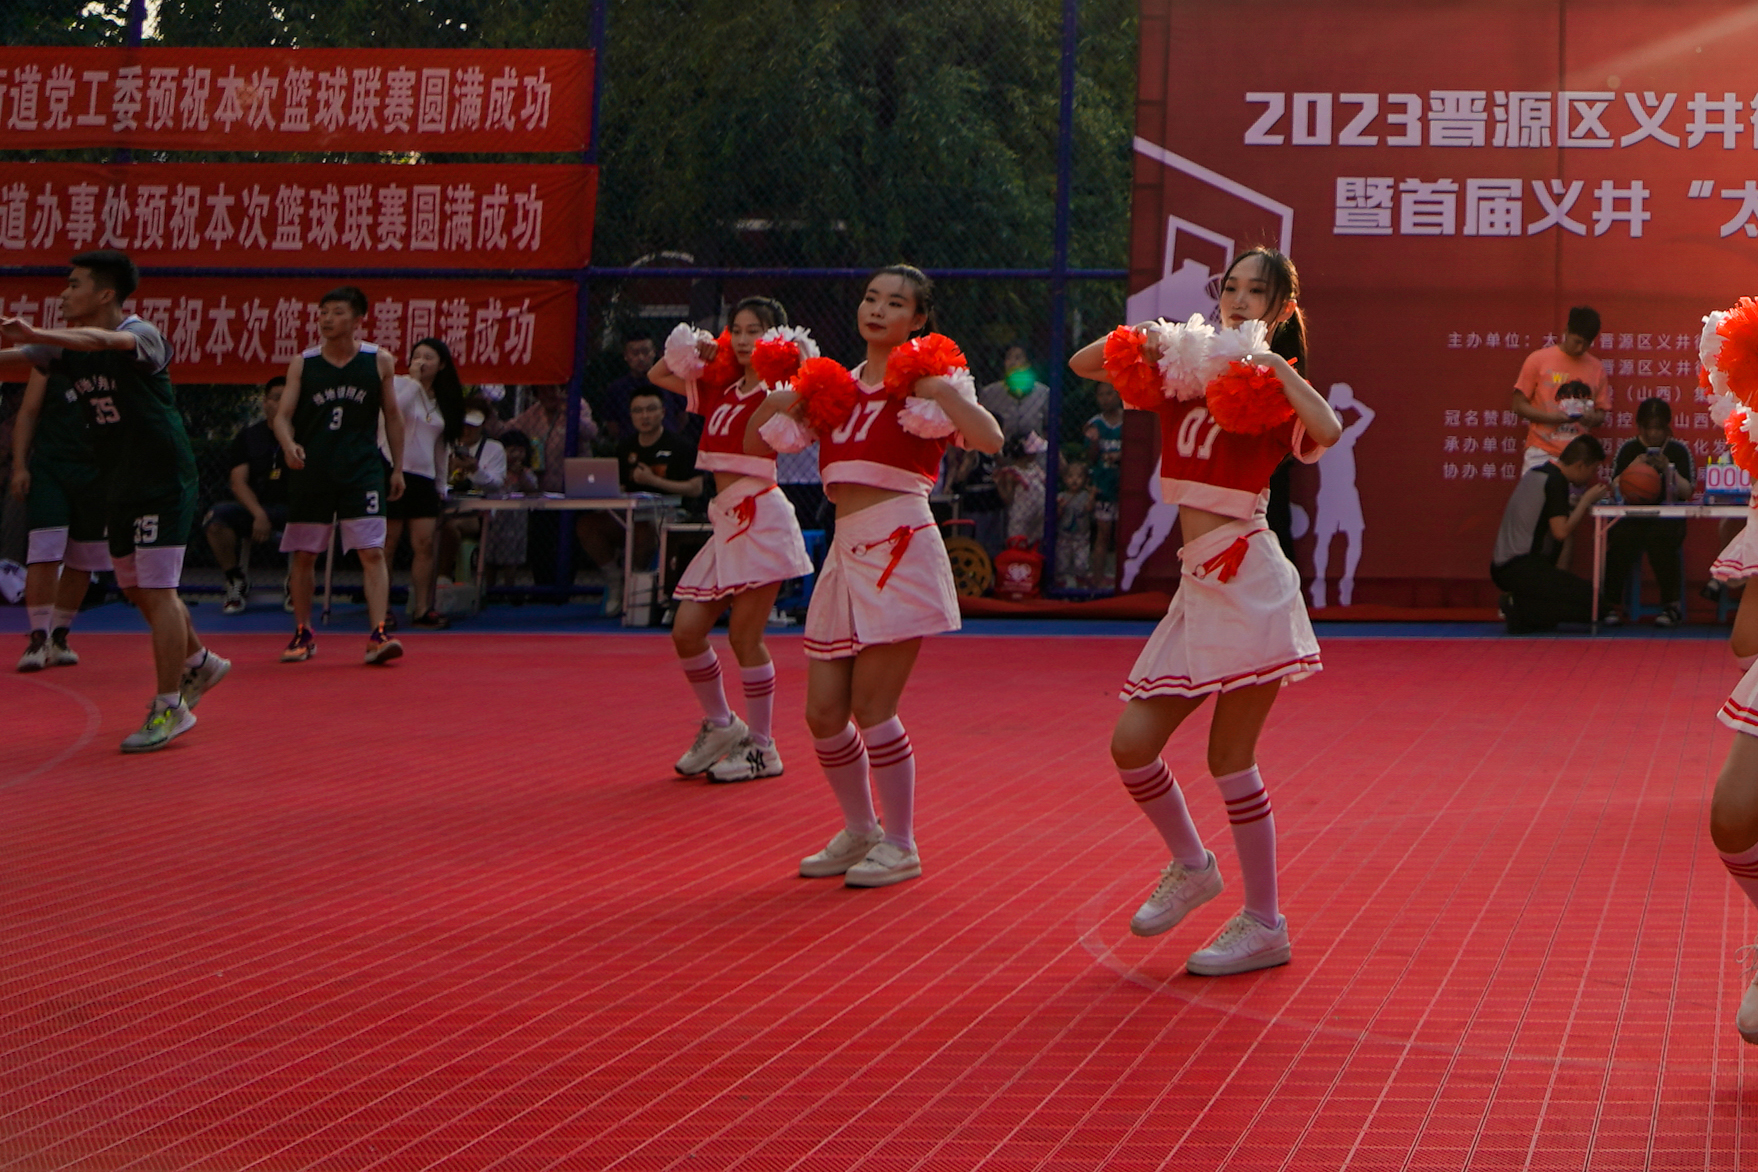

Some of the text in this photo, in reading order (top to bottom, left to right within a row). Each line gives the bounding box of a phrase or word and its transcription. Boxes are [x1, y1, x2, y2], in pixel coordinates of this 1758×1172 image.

[0, 64, 553, 134] 道党工委预祝本次篮球联赛圆满成功
[0, 182, 543, 252] 道办事处预祝本次篮球联赛圆满成功
[328, 406, 344, 430] 3
[366, 490, 380, 514] 3
